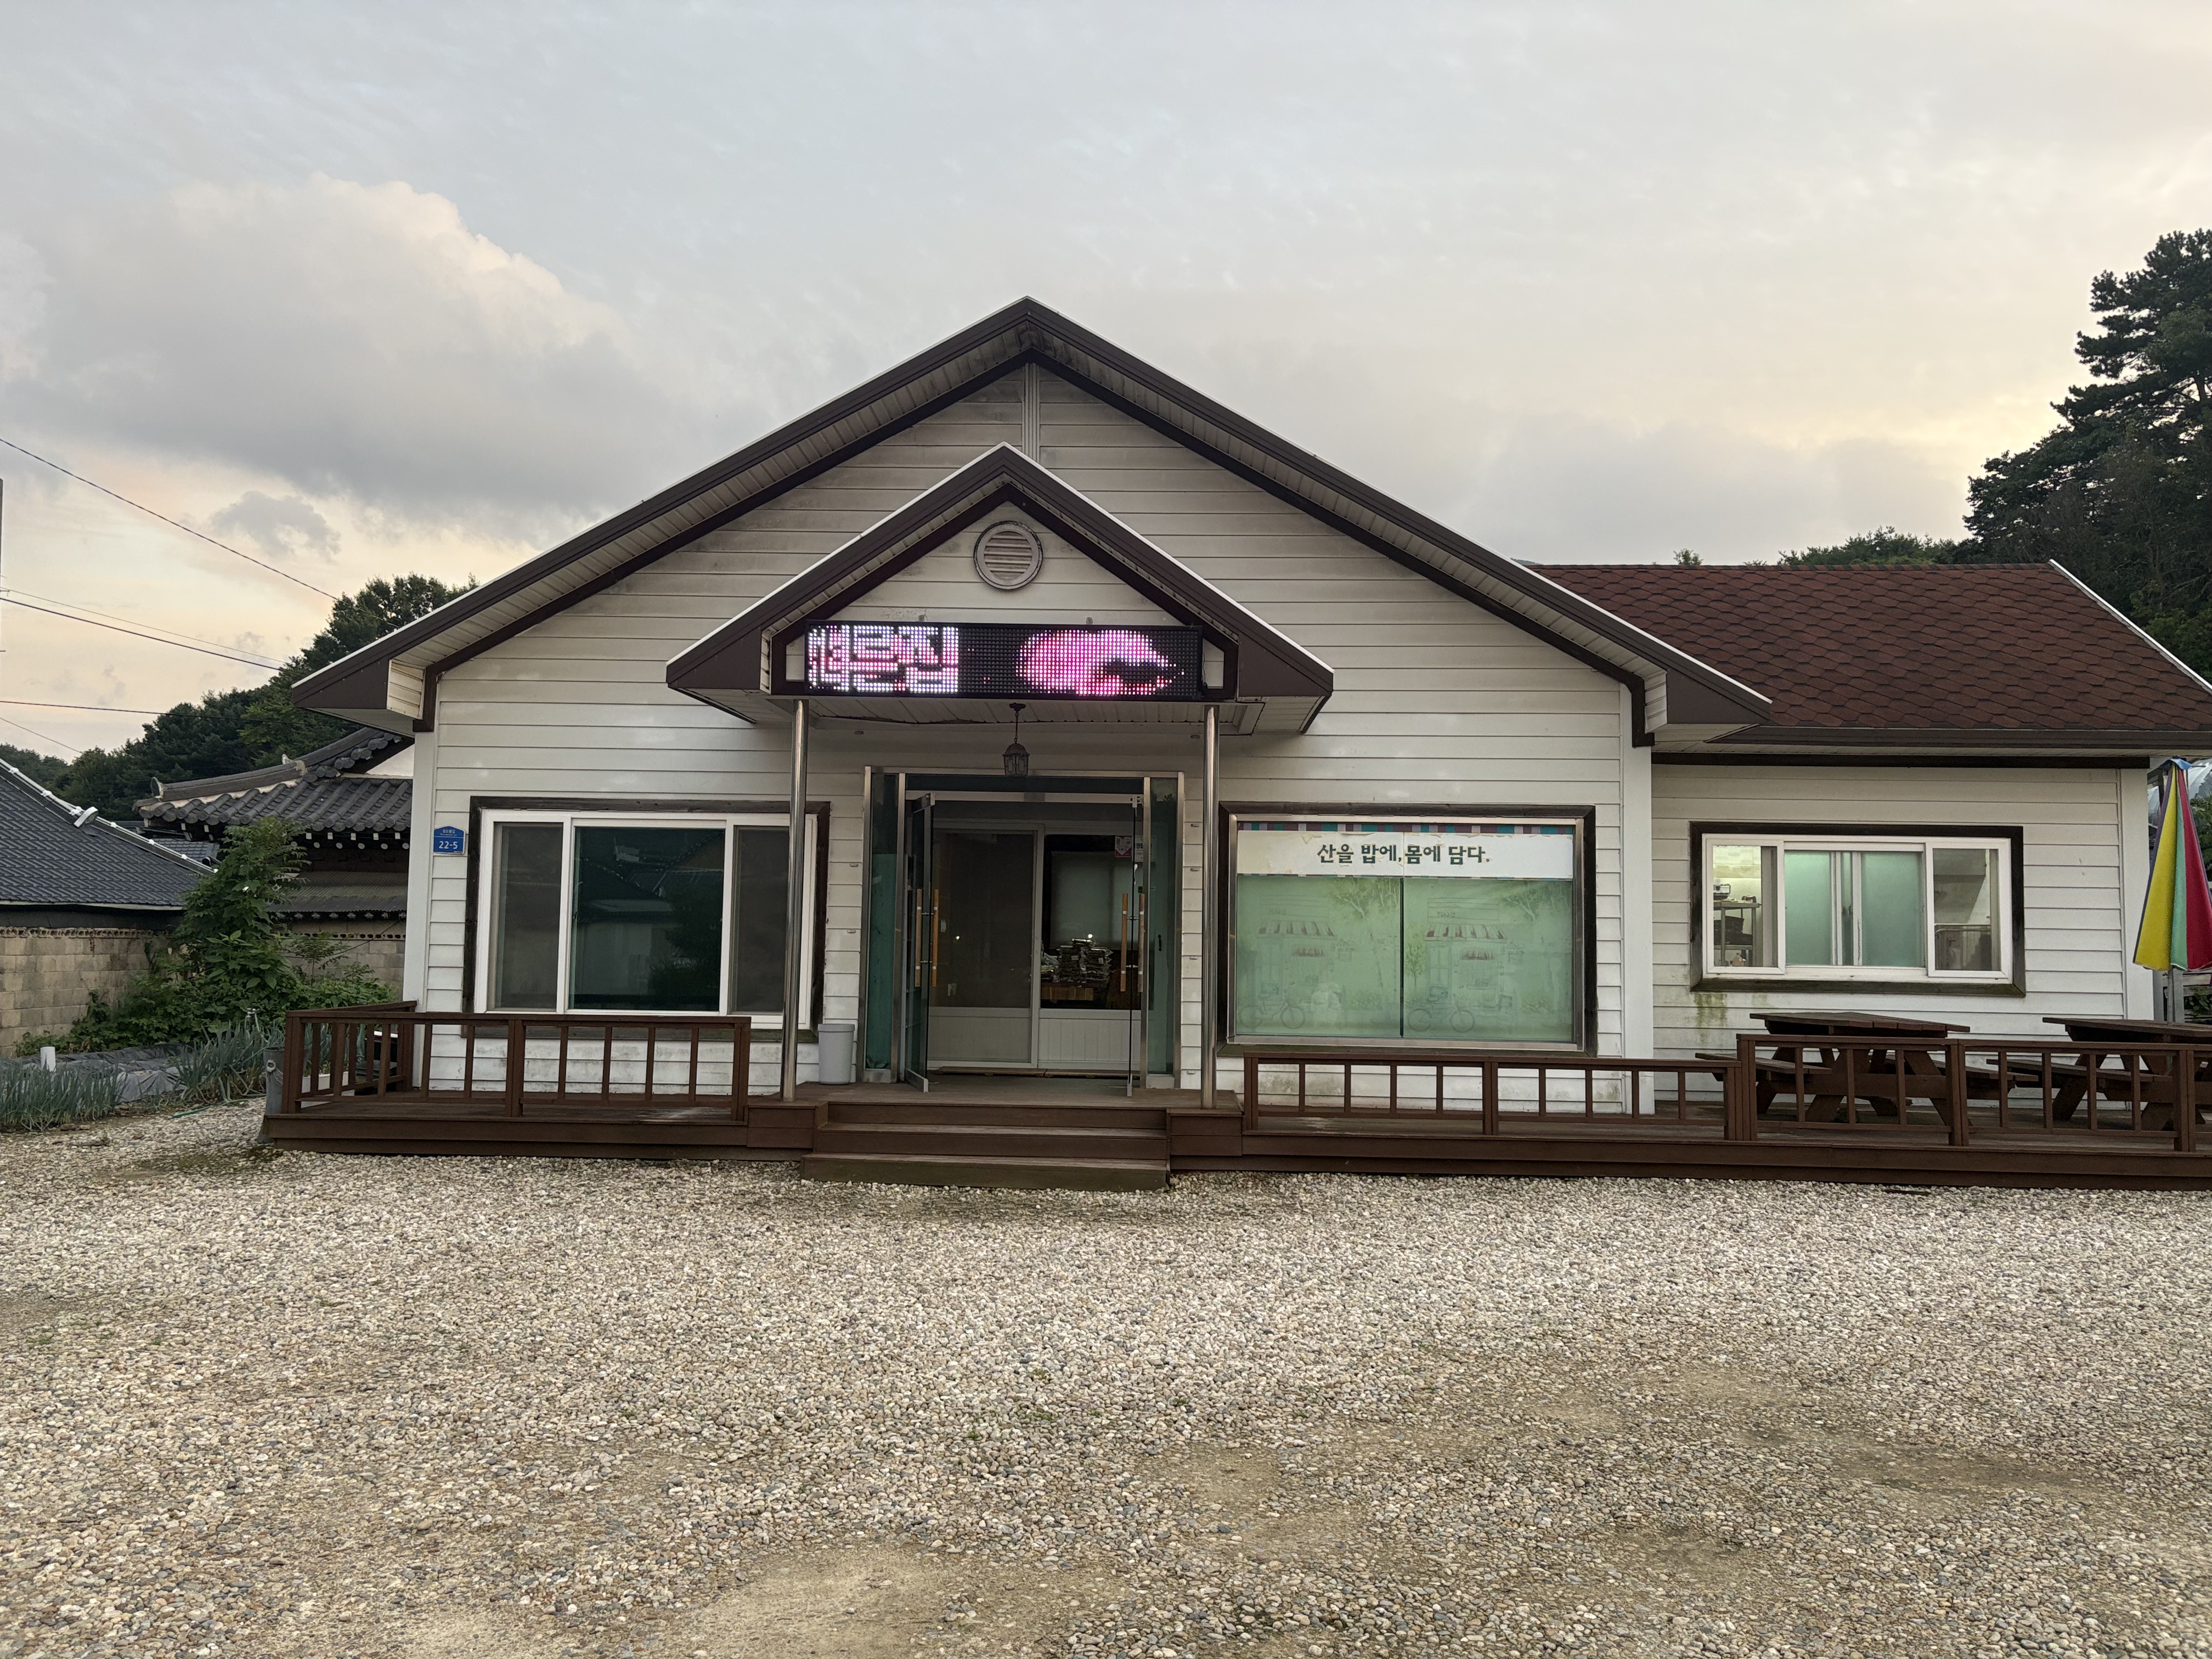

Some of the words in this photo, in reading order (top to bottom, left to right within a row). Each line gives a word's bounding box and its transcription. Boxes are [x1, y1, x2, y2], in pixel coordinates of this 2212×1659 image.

[439, 840, 458, 850] 22-5
[1317, 844, 1354, 864] 산을
[1361, 844, 1402, 864] 밥에,
[1405, 845, 1441, 865] 몸에
[1448, 845, 1490, 865] 담다.
